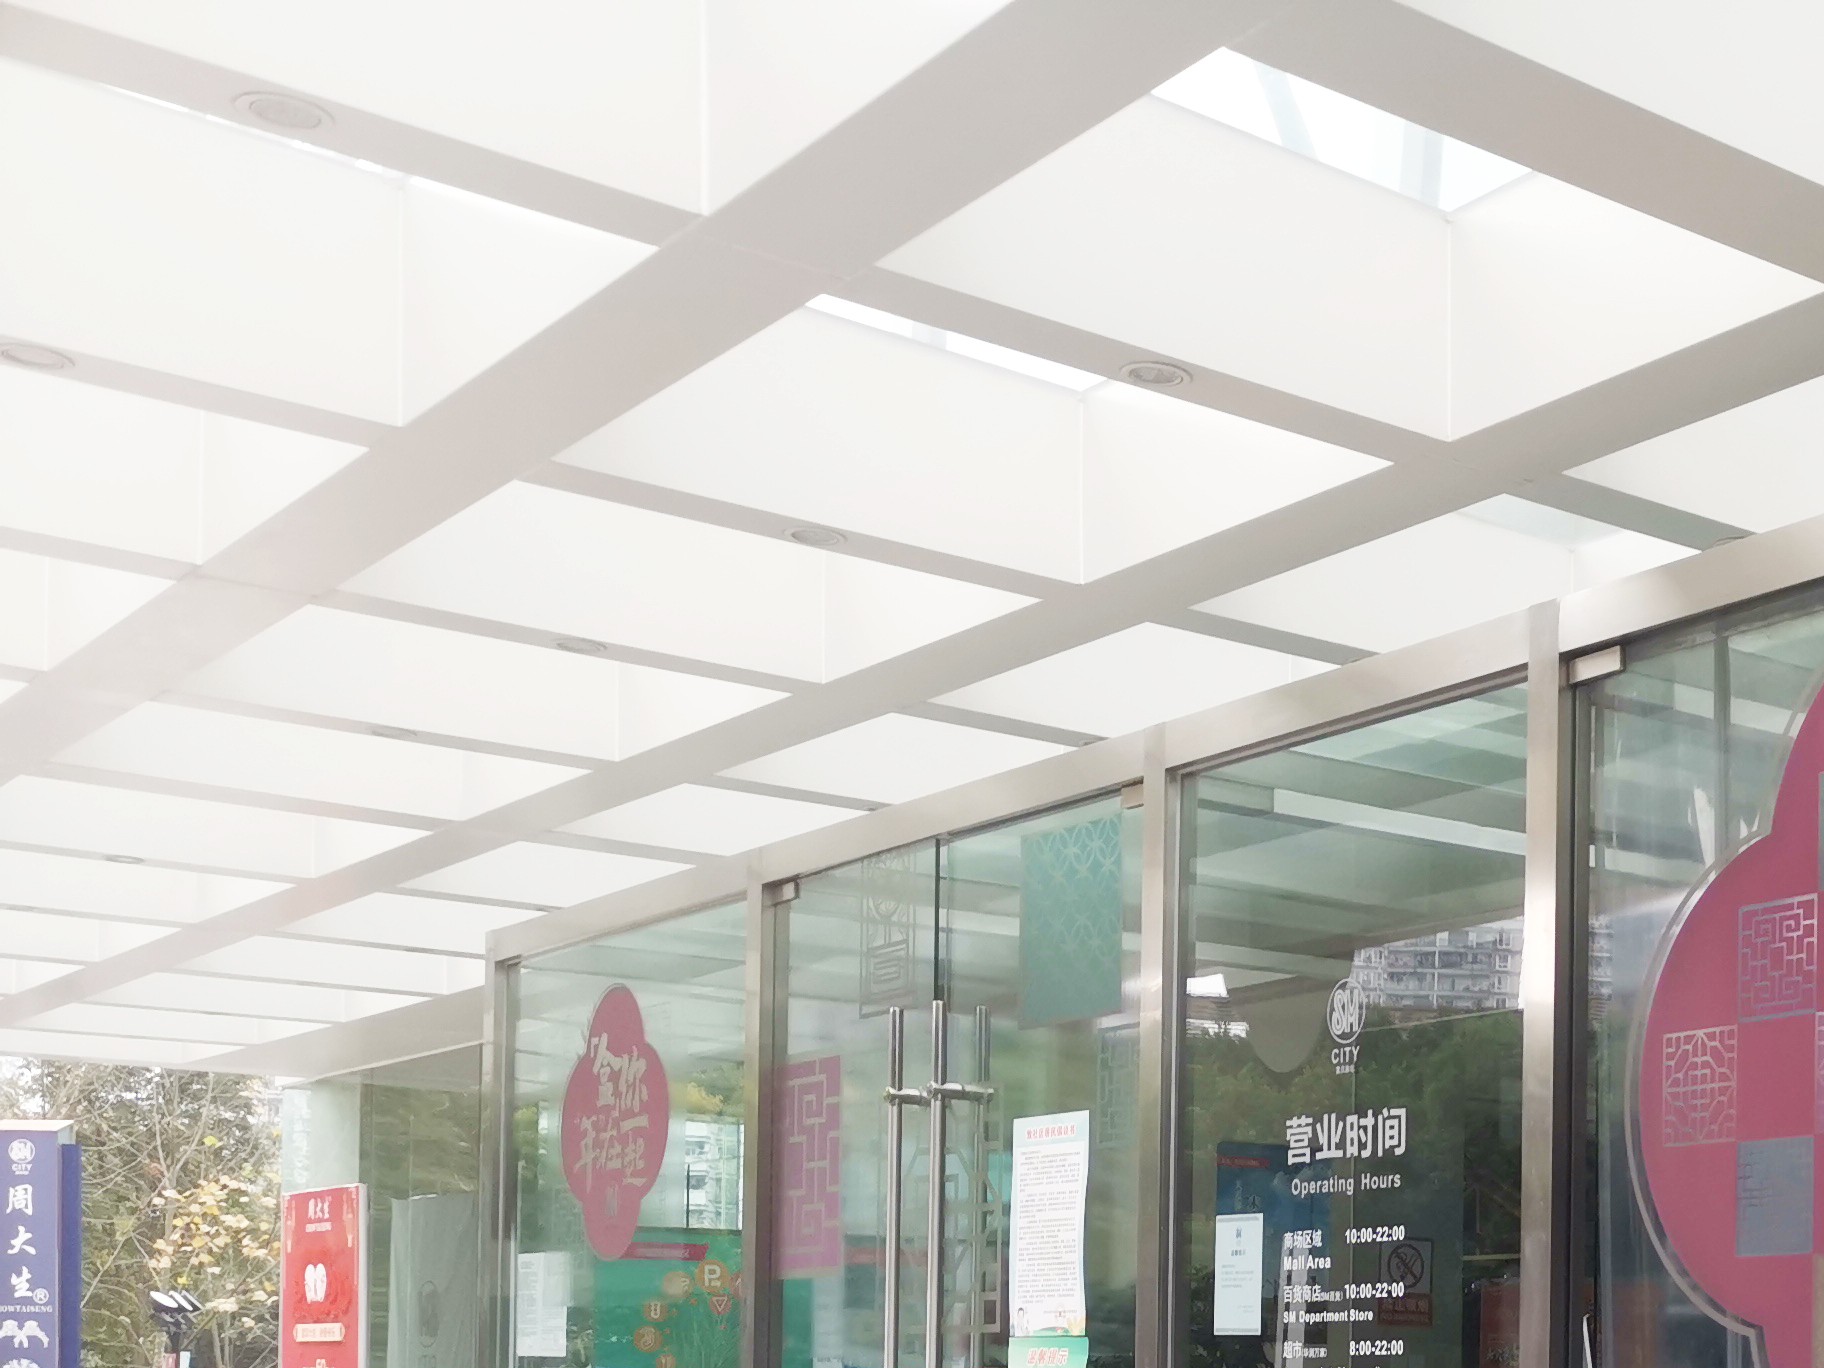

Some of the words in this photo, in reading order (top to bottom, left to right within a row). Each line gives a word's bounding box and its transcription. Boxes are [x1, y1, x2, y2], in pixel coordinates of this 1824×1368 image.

[1330, 988, 1360, 1037] SM
[1331, 1045, 1360, 1065] CITY
[1285, 1107, 1407, 1166] 营业时间
[1291, 1174, 1354, 1199] Operating
[1360, 1173, 1401, 1191] Hours
[6, 1183, 37, 1298] 周大生
[1283, 1229, 1322, 1250] 商场区域
[1344, 1225, 1405, 1244] 10:00-22:00
[1283, 1255, 1304, 1271] Mall
[1306, 1255, 1331, 1269] Area
[1344, 1281, 1405, 1300] 10:00-22:00
[1283, 1311, 1297, 1323] SM
[1299, 1309, 1348, 1325] Department
[1349, 1308, 1374, 1321] Store
[1349, 1339, 1404, 1356] 8:00-22:00
